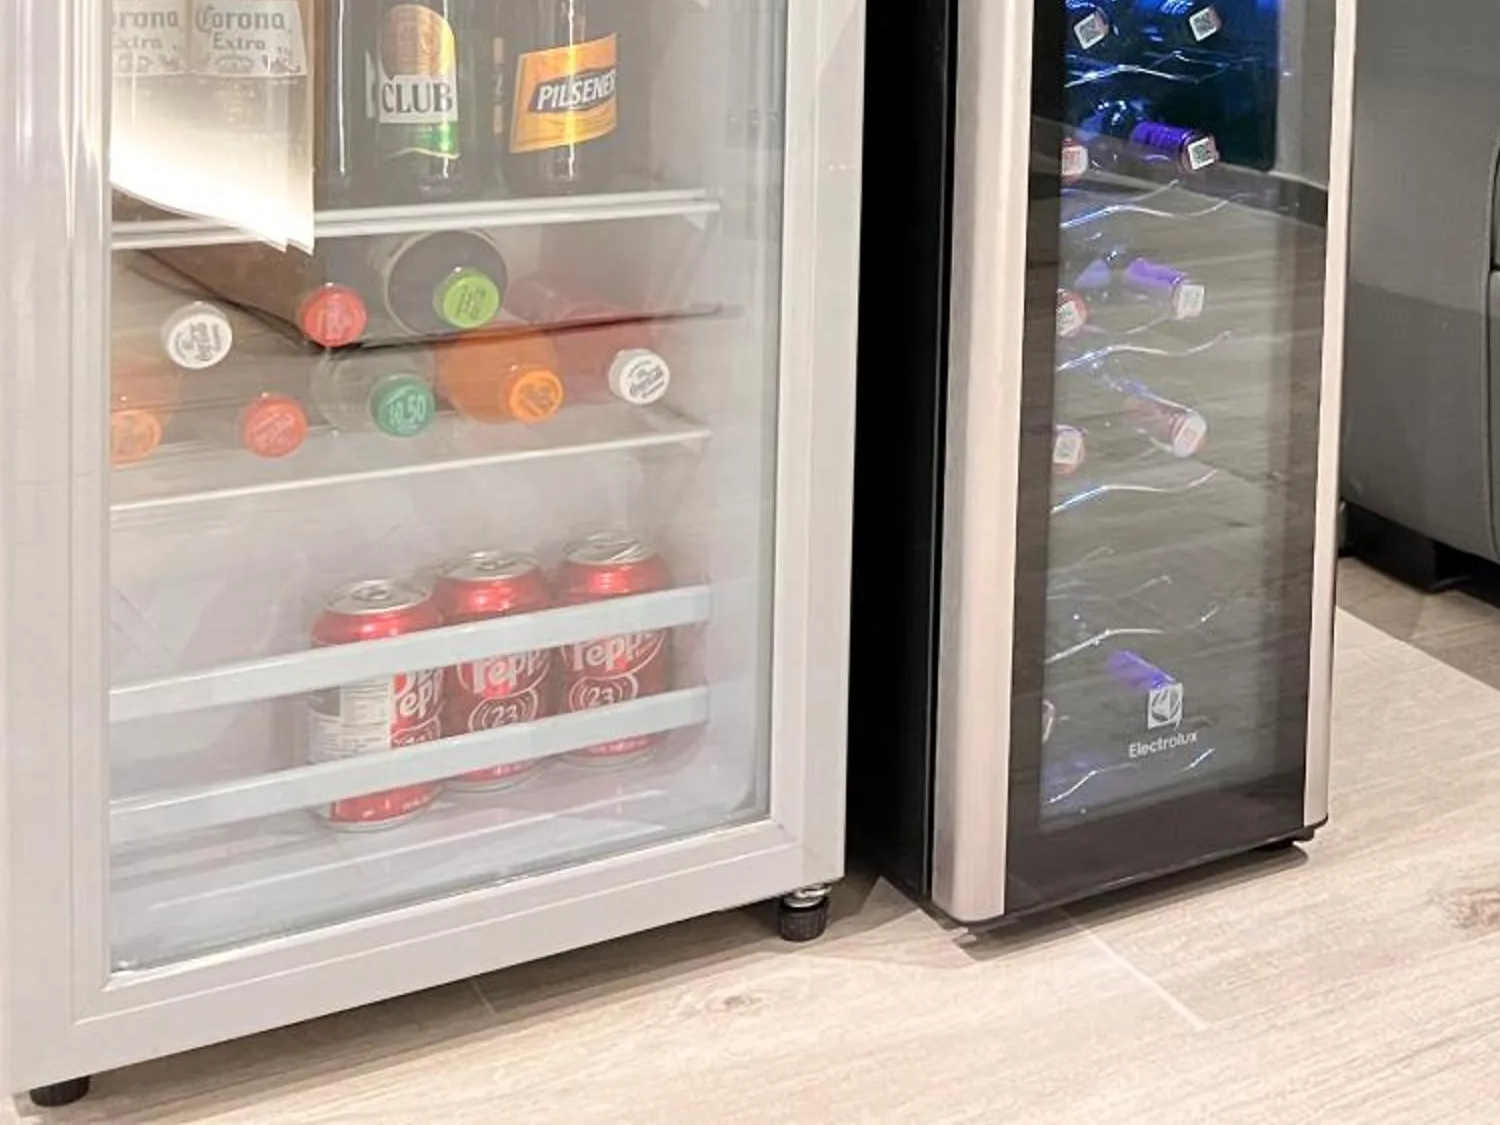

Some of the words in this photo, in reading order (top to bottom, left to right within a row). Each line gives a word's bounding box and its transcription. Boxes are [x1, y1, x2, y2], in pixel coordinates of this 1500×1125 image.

[195, 3, 286, 34] Corona
[212, 32, 266, 51] Extra
[381, 81, 453, 114] CLUB
[589, 686, 615, 707] 23
[1128, 730, 1198, 759] Electrolux
